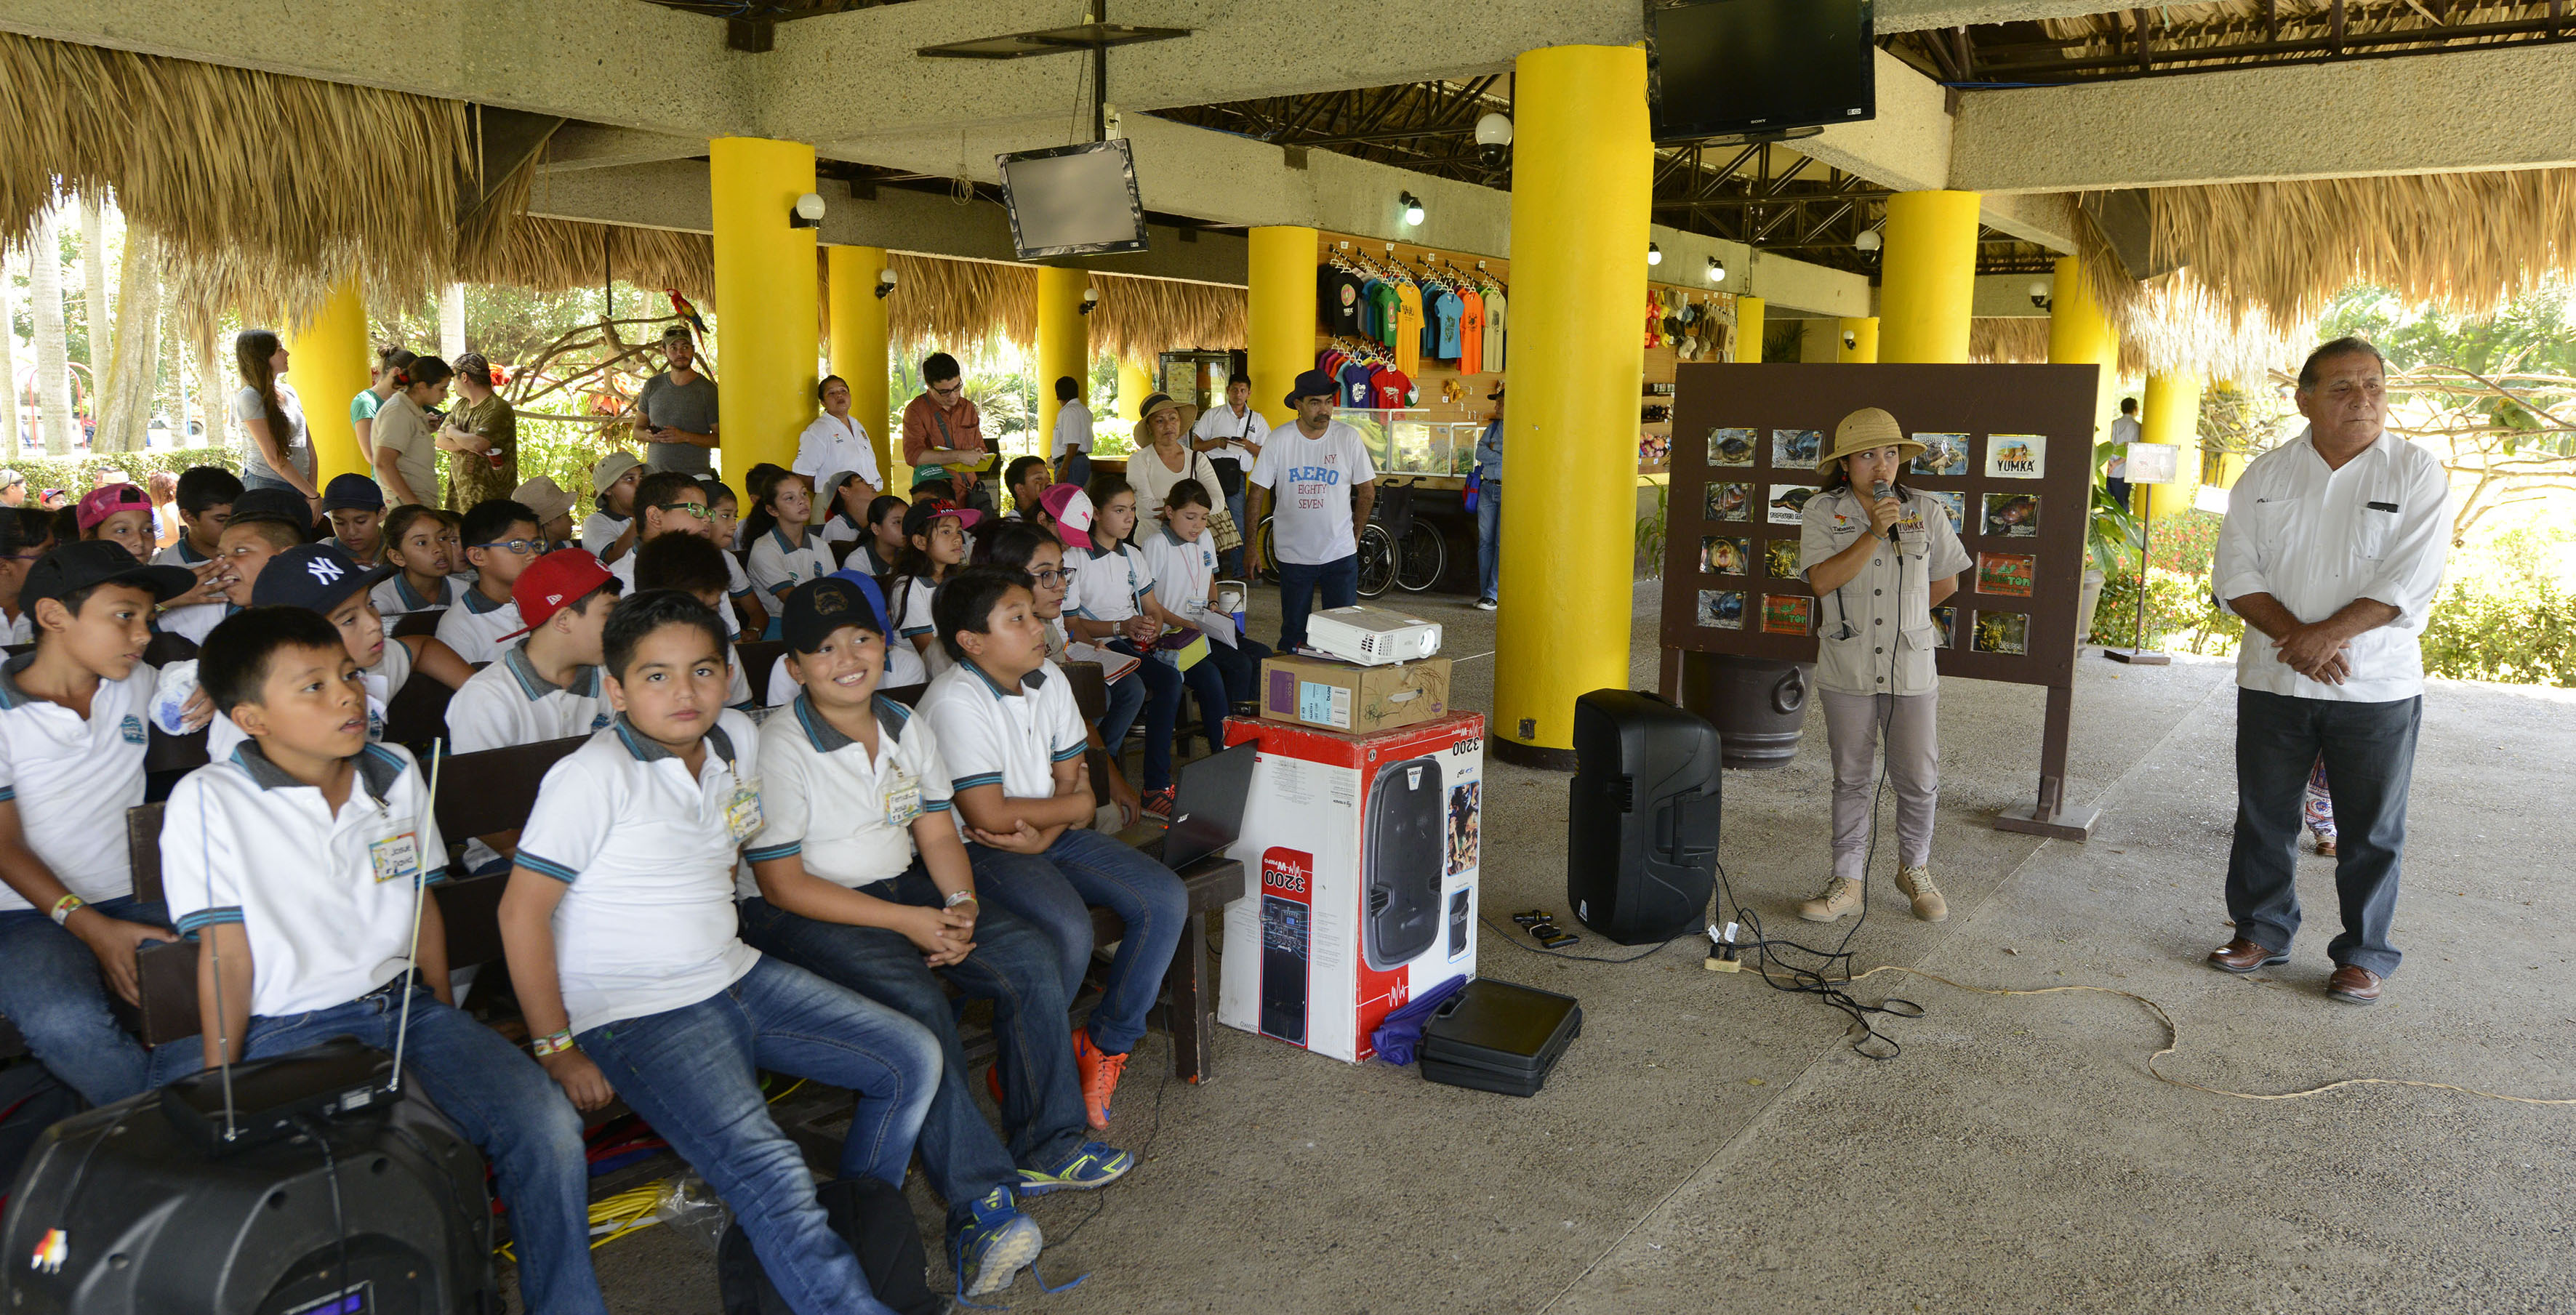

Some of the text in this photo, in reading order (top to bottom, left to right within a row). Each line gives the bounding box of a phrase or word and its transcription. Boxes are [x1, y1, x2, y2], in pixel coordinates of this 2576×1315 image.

[1324, 454, 1337, 465] NY
[1997, 459, 2034, 472] YUMKÁ
[1289, 466, 1339, 486] AERO
[1298, 484, 1327, 494] EIGHTY
[1298, 499, 1324, 509] SEVEN
[308, 557, 345, 585] NY
[1453, 736, 1480, 757] 3200
[1177, 813, 1189, 824] acer
[1264, 870, 1305, 893] 3200
